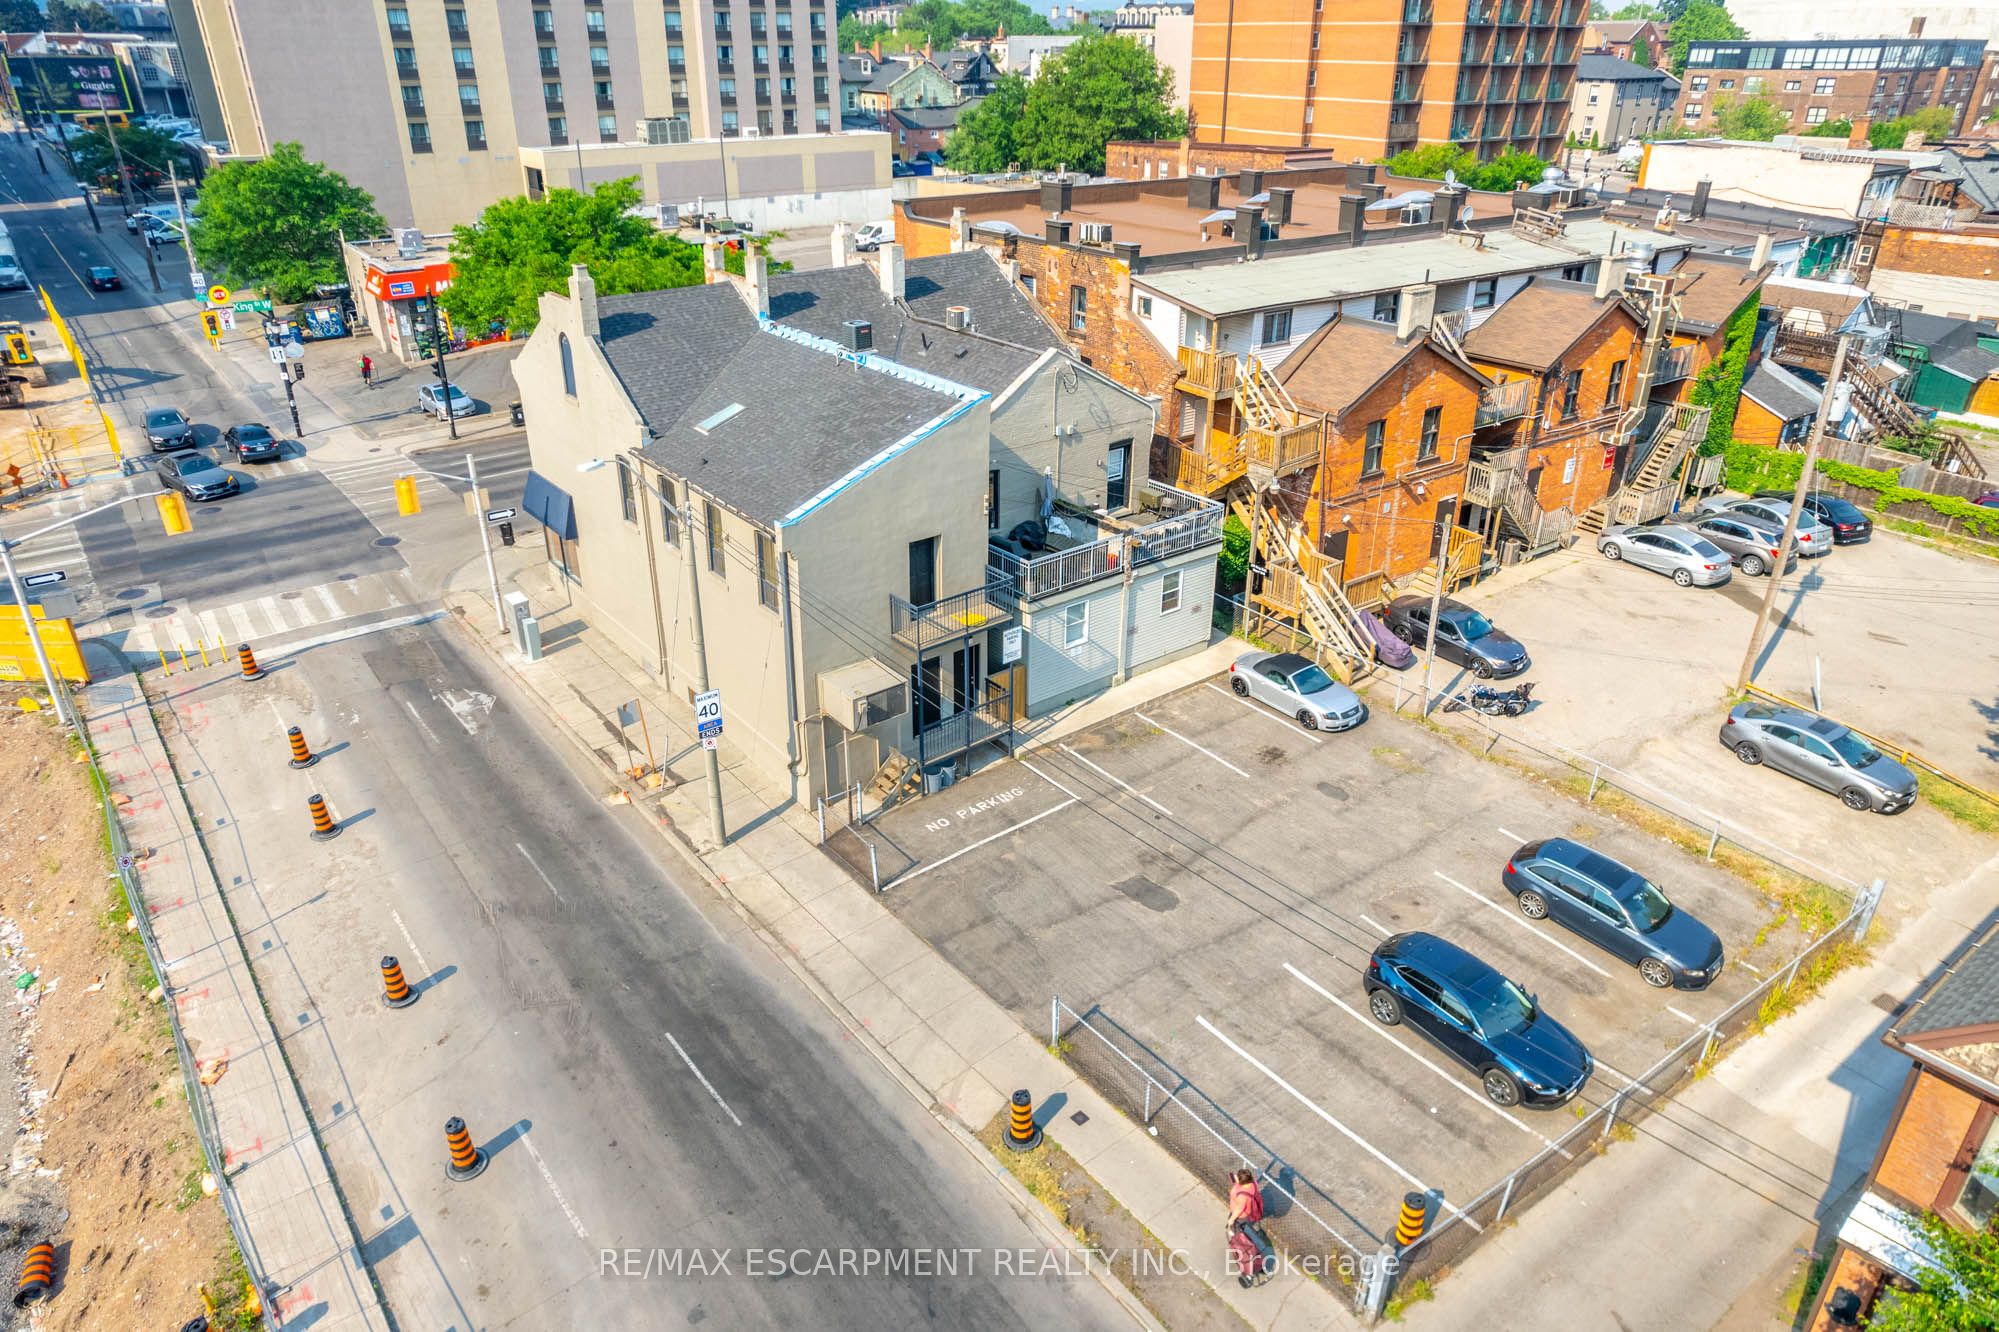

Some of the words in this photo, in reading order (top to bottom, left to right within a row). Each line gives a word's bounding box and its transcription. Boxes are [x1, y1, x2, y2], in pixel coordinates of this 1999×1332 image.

[80, 81, 116, 91] Giggles
[233, 303, 254, 313] King
[262, 300, 272, 309] W
[697, 693, 718, 702] MAXIMUM
[698, 702, 719, 718] 40
[702, 727, 720, 738] ENDS
[925, 818, 950, 833] NO
[956, 787, 1024, 820] PARKING
